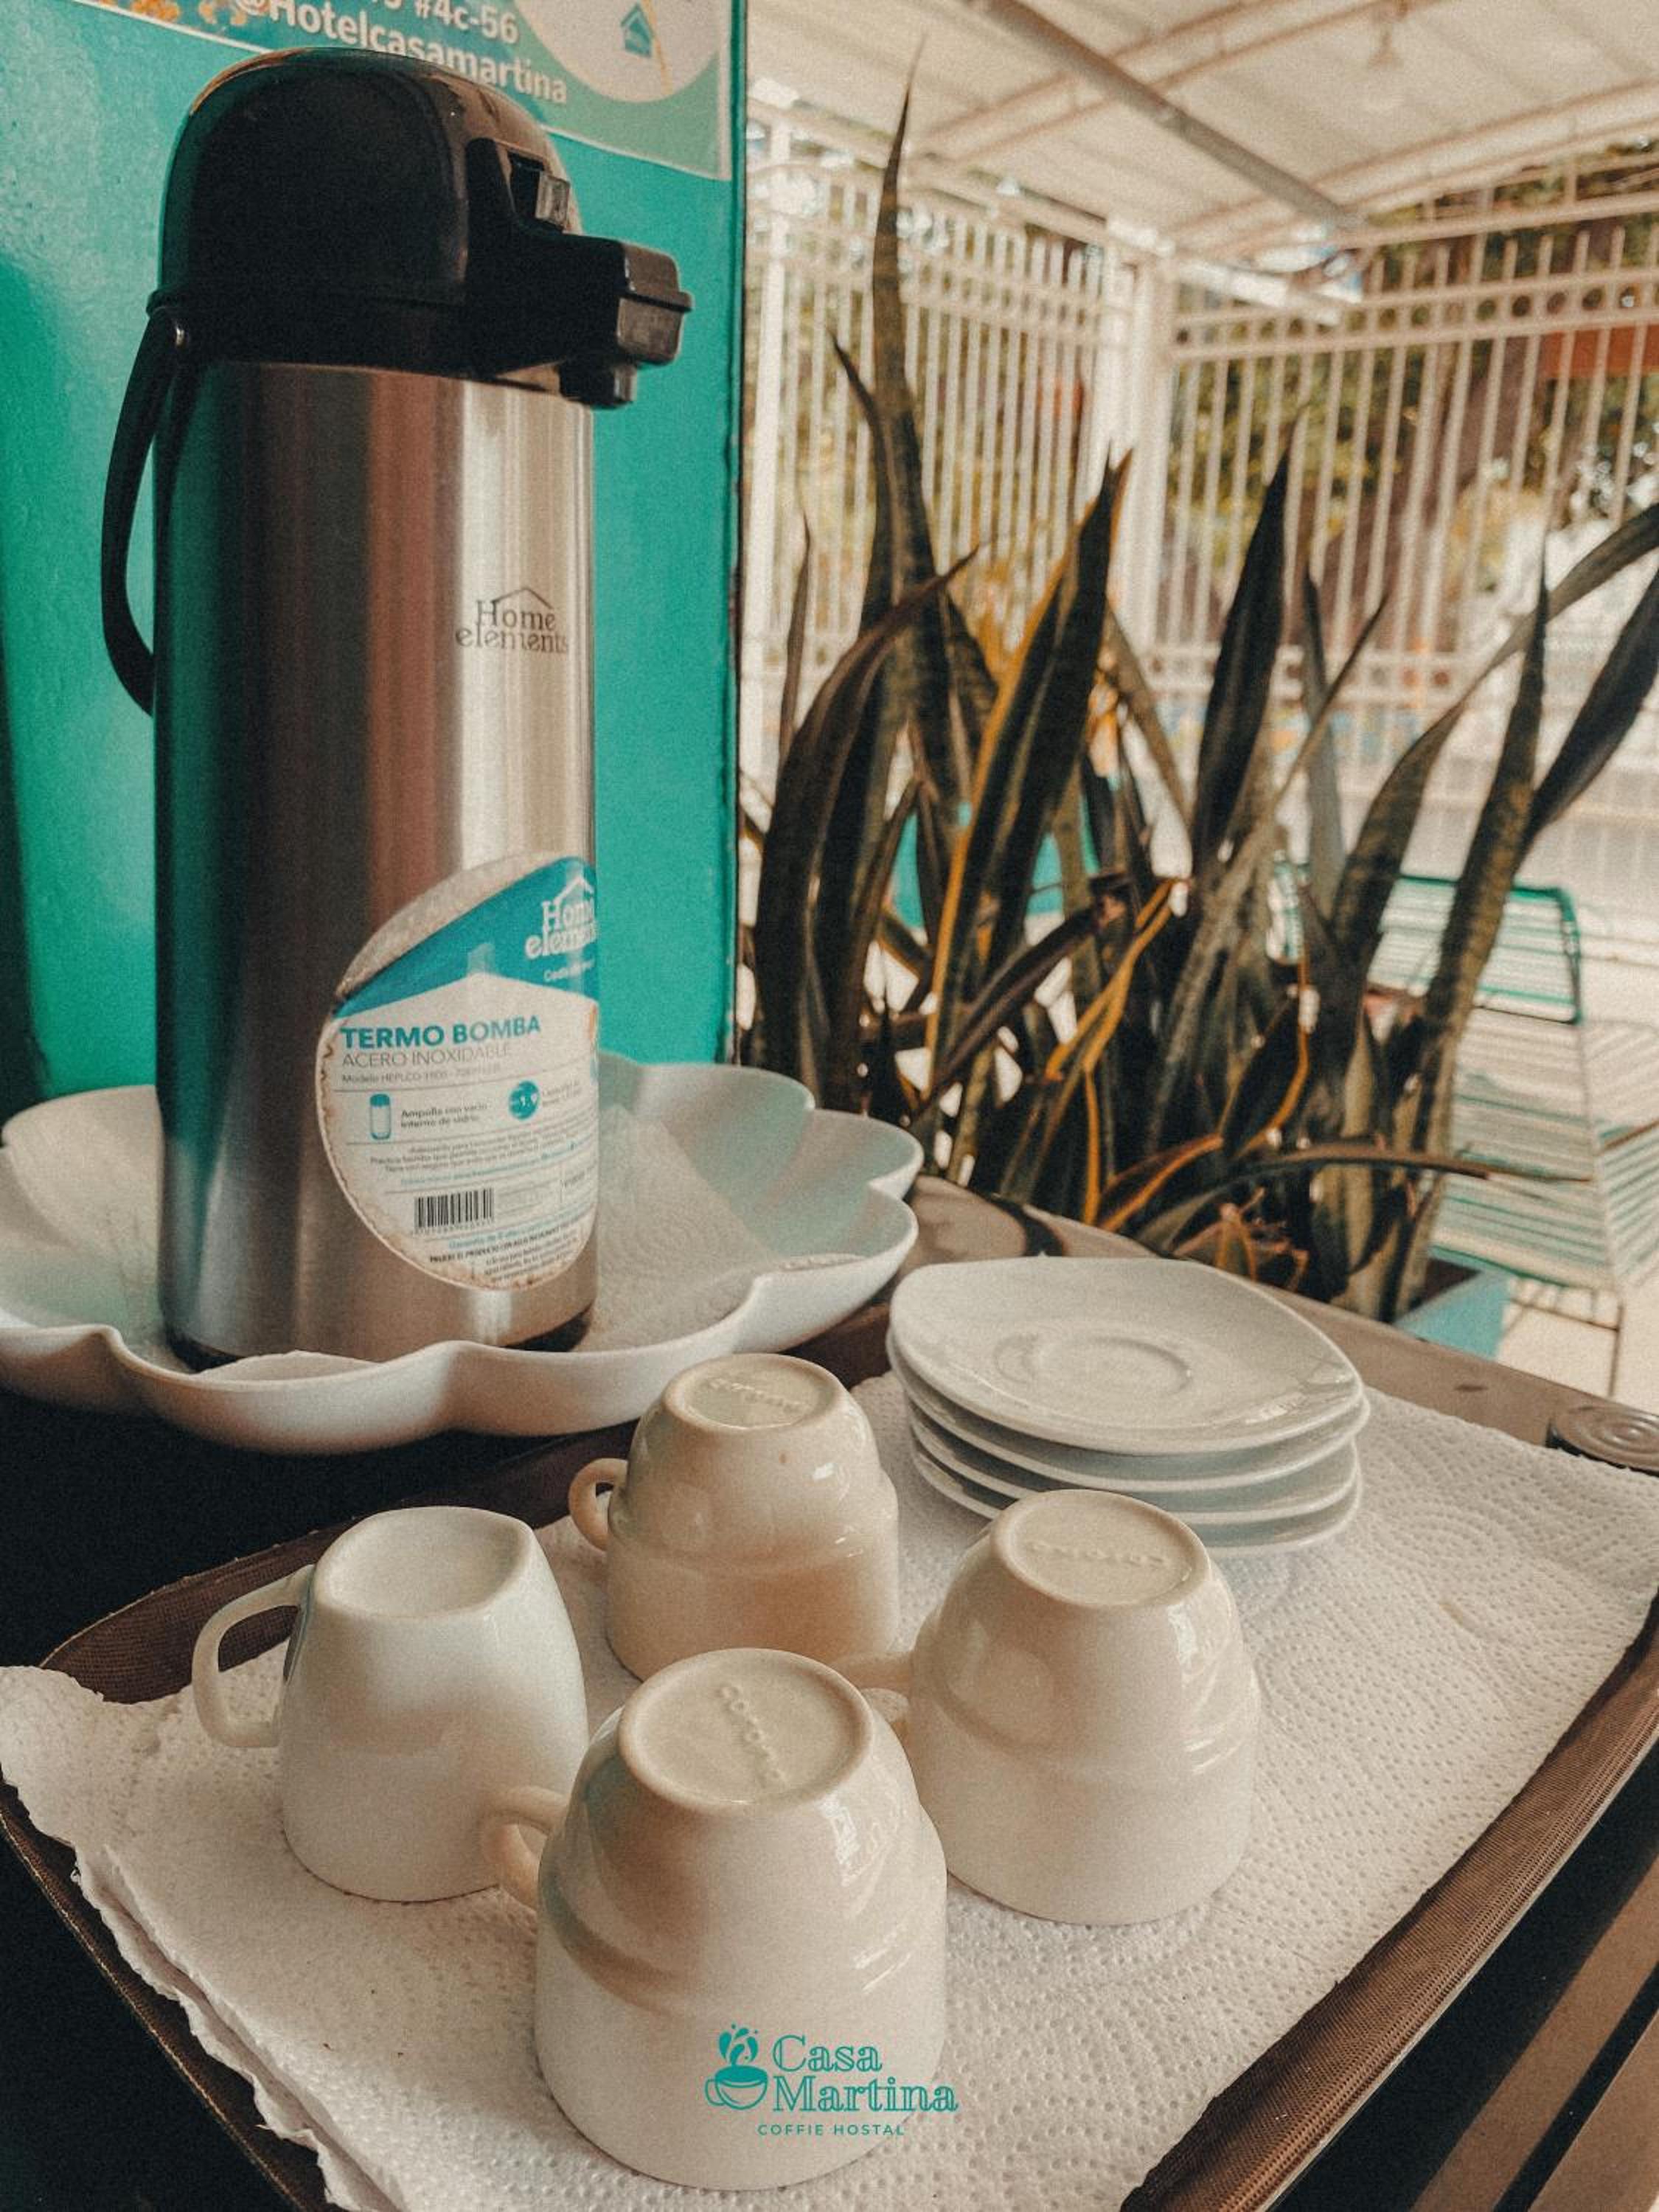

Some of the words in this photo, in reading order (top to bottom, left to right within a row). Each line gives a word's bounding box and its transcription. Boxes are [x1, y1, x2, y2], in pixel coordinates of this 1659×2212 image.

[476, 599, 555, 630] Home
[339, 1026, 445, 1048] TERMO
[452, 1015, 540, 1044] BOMBA
[341, 1051, 407, 1068] ACERO
[411, 1043, 509, 1066] INOXIDABLE
